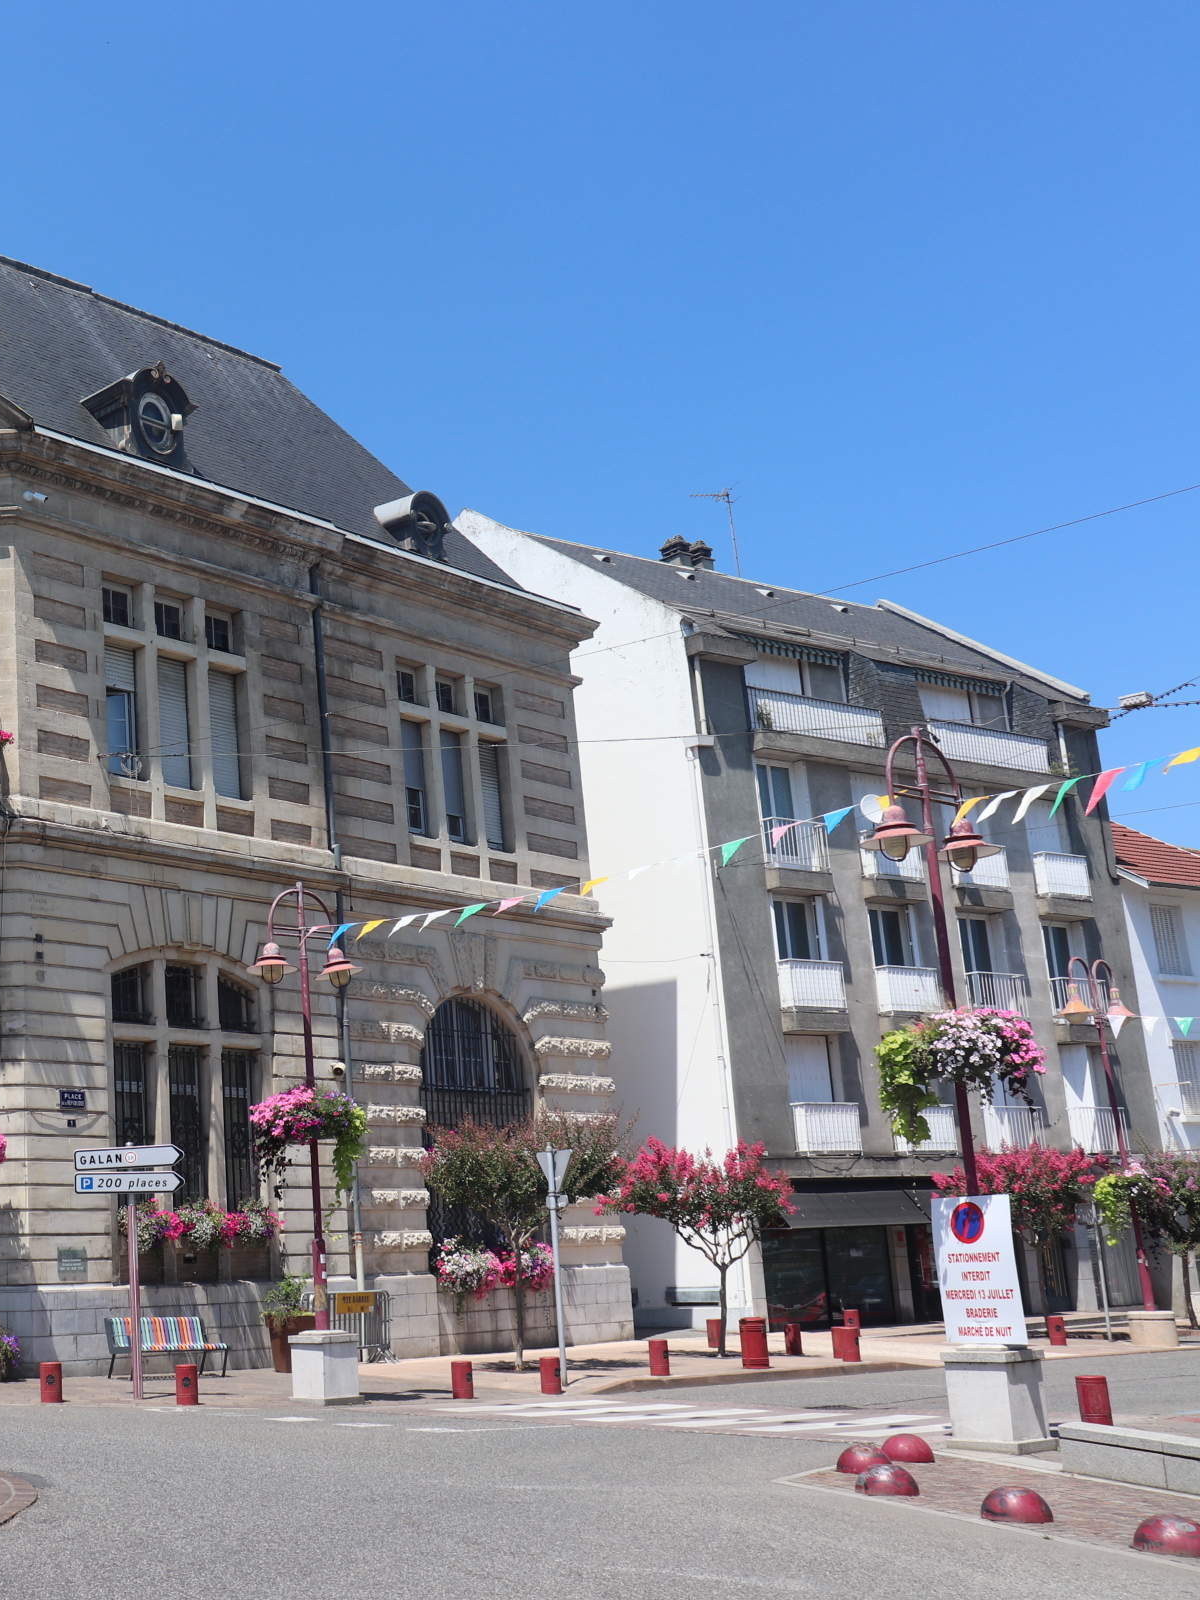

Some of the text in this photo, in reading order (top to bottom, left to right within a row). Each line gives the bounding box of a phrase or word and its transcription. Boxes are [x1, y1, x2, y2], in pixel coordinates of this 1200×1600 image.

[80, 1153, 123, 1165] GALAN
[97, 1178, 122, 1188] 200
[128, 1178, 168, 1190] places
[947, 1252, 1000, 1263] STATIONNEMENT
[961, 1271, 990, 1281] INTERDIT
[945, 1289, 1014, 1300] MERCREDI 13 JUILLET
[966, 1308, 998, 1318] BRADERIE
[958, 1325, 1012, 1337] MARCHÉ DE NUIT
